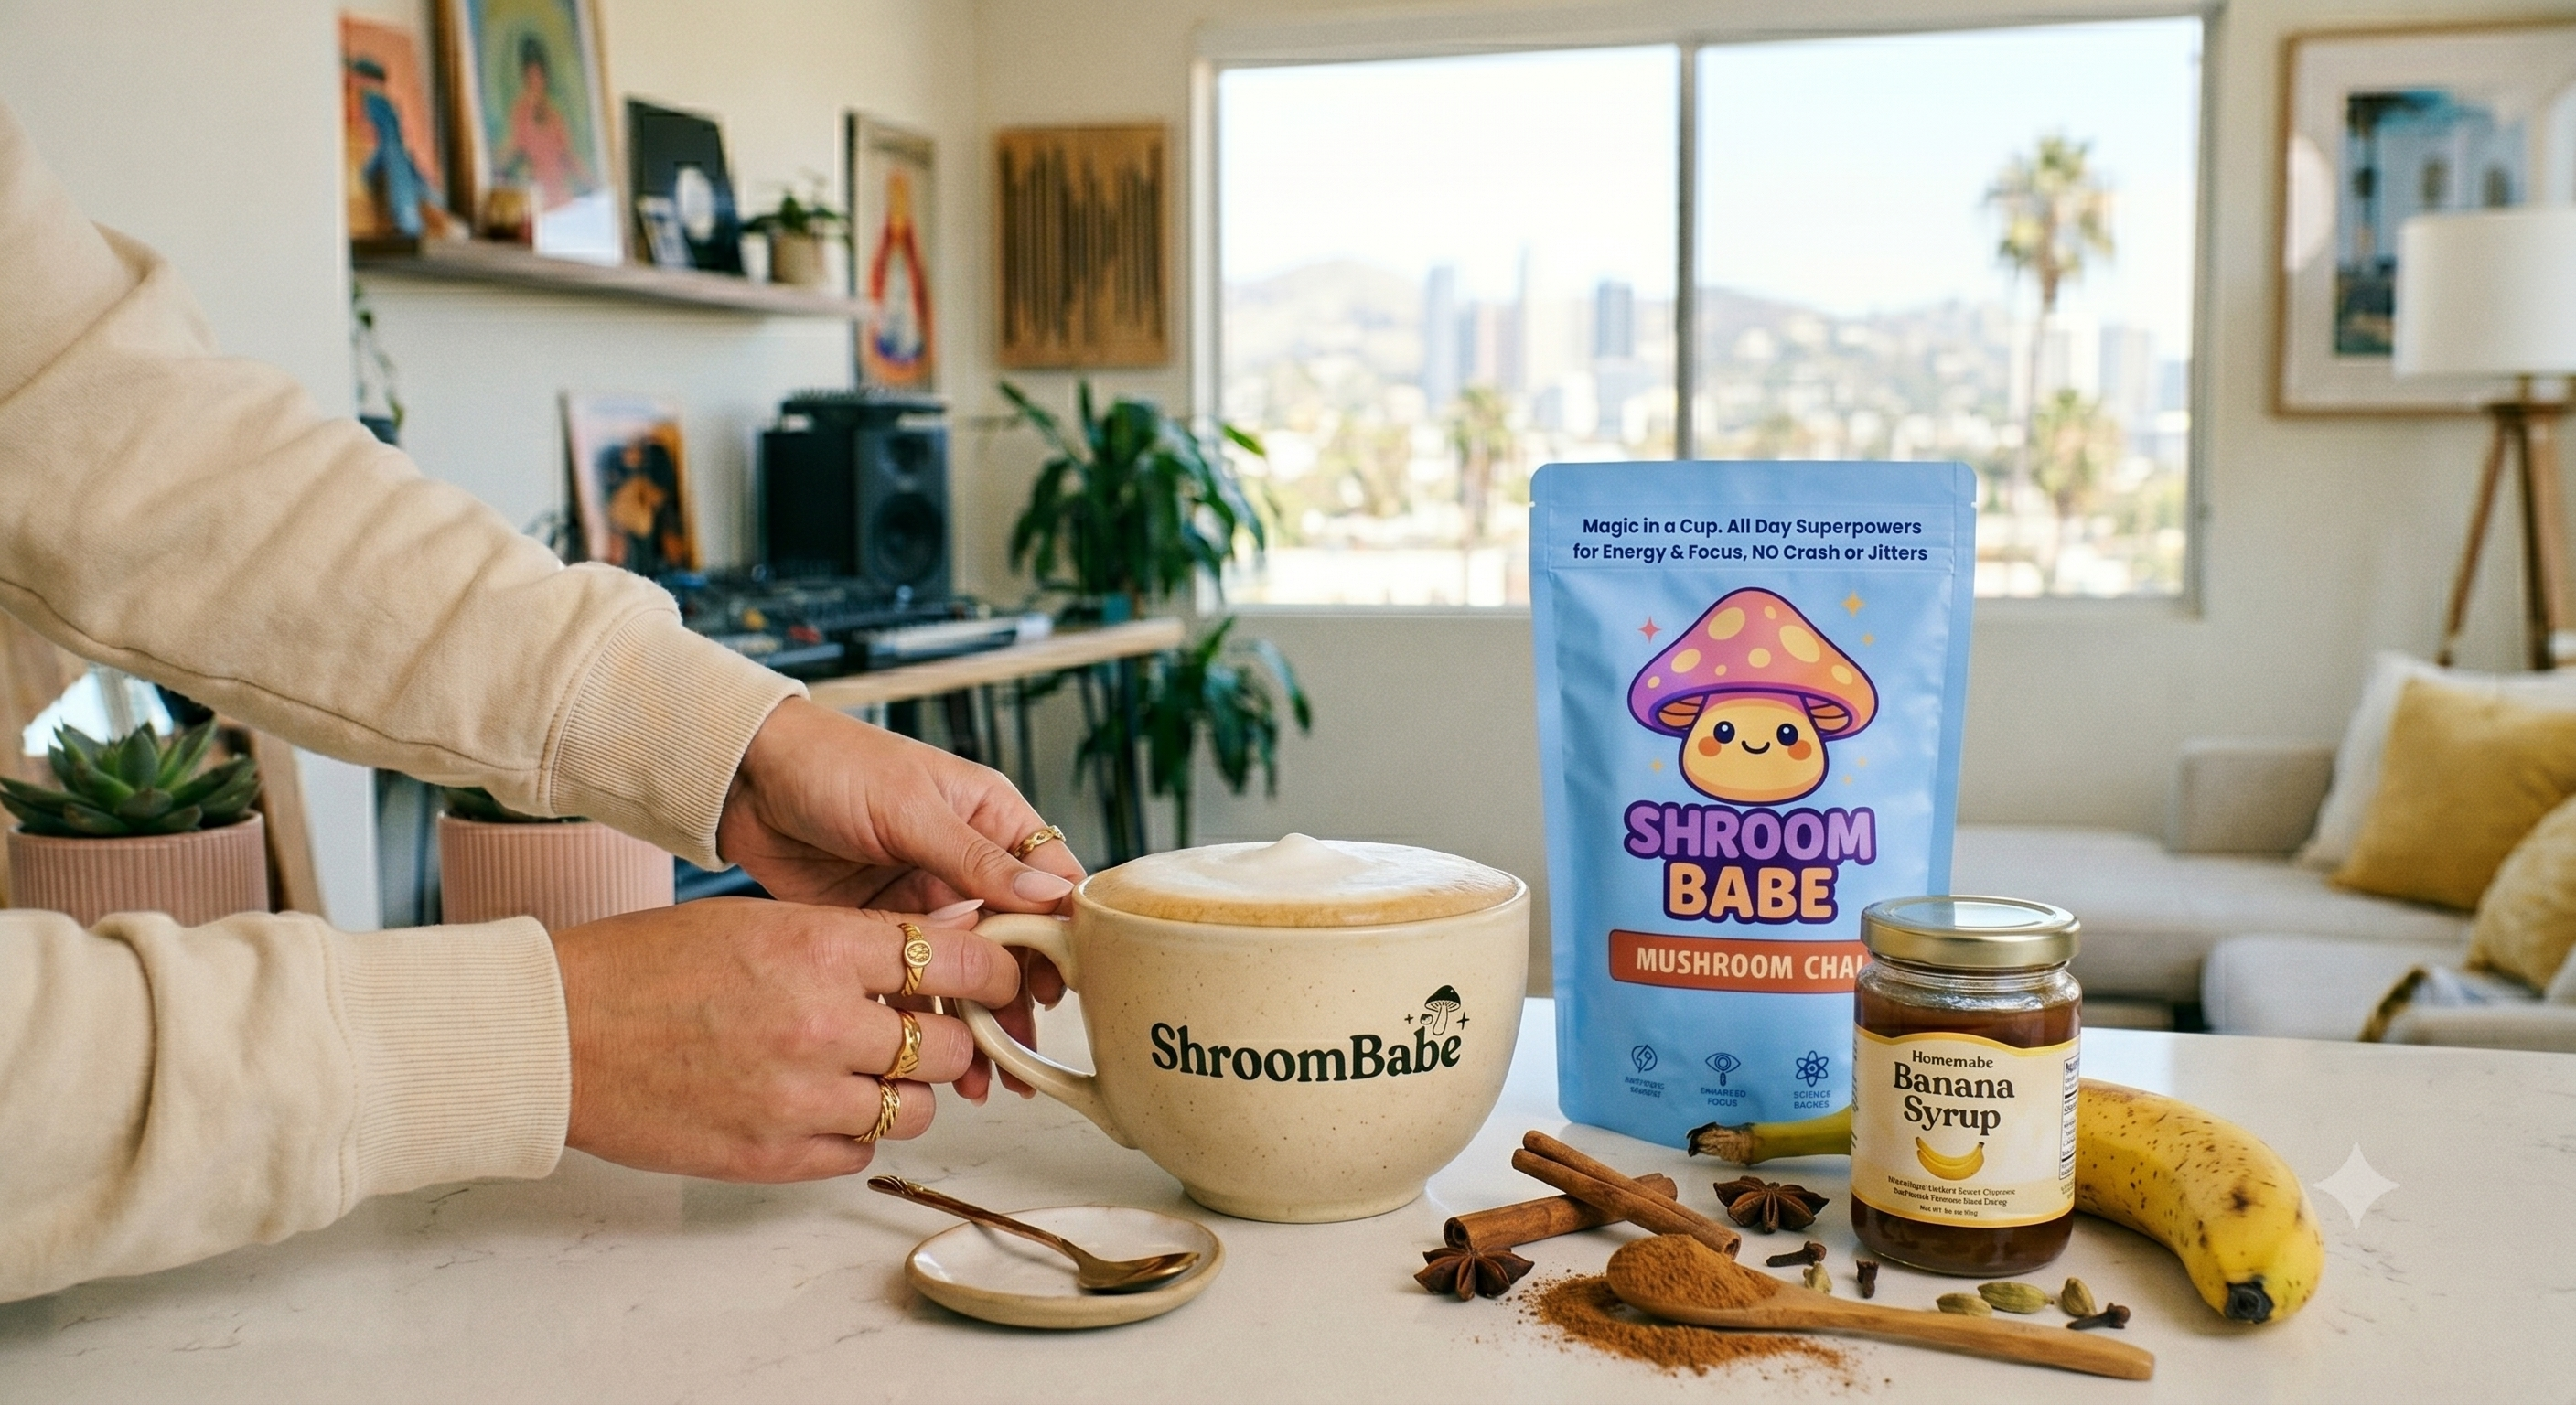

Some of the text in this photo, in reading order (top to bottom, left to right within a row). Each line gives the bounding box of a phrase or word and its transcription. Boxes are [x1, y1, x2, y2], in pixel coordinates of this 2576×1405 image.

[1583, 517, 1923, 539] Magic in a Cup. All Day Superpowers
[1572, 542, 1929, 563] for Energy & Focus, NO Crash or Jitters
[1626, 803, 1874, 863] SHROOM
[1668, 860, 1834, 920] BABE
[1636, 947, 1794, 980] MUSHROOM
[1150, 1022, 1462, 1083] ShroomBabe
[1912, 1049, 1994, 1069] Homemabe
[1793, 1089, 1831, 1099] SCIENCE
[1893, 1061, 2015, 1099] Banana
[1707, 1098, 1738, 1107] FOCUS
[1903, 1094, 2002, 1136] Syrup
